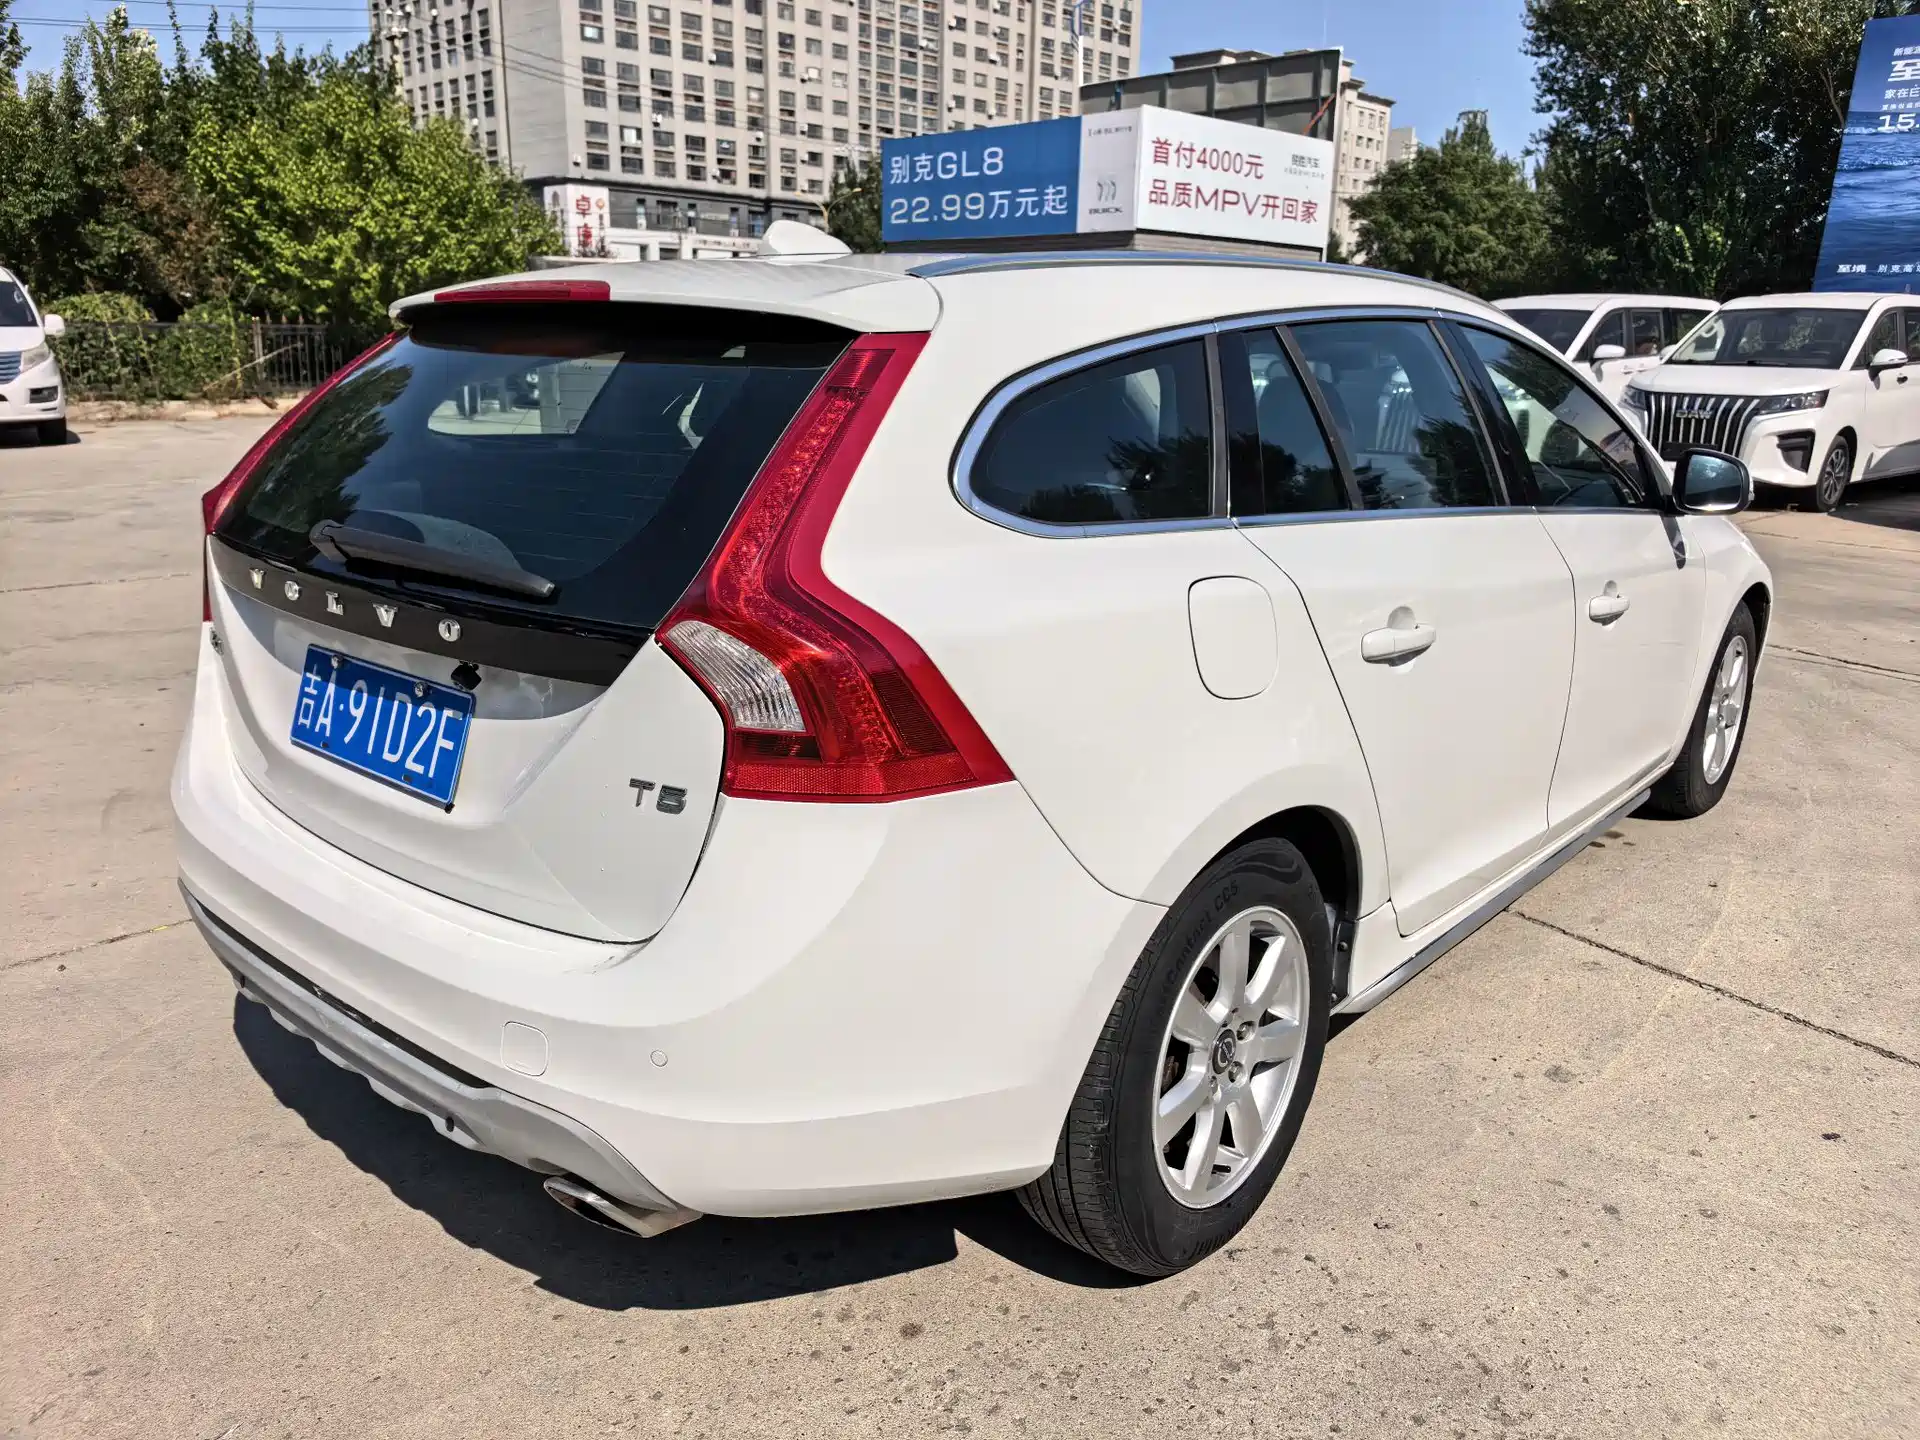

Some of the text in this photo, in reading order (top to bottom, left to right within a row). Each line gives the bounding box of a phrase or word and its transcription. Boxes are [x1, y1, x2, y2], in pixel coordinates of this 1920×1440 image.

[889, 147, 1004, 185] 别克GL8
[1151, 136, 1265, 180] 首付4000元
[889, 186, 1069, 225] 22.99万元起
[1148, 178, 1319, 224] 品质MPV开回家
[248, 567, 462, 643] VOLVO
